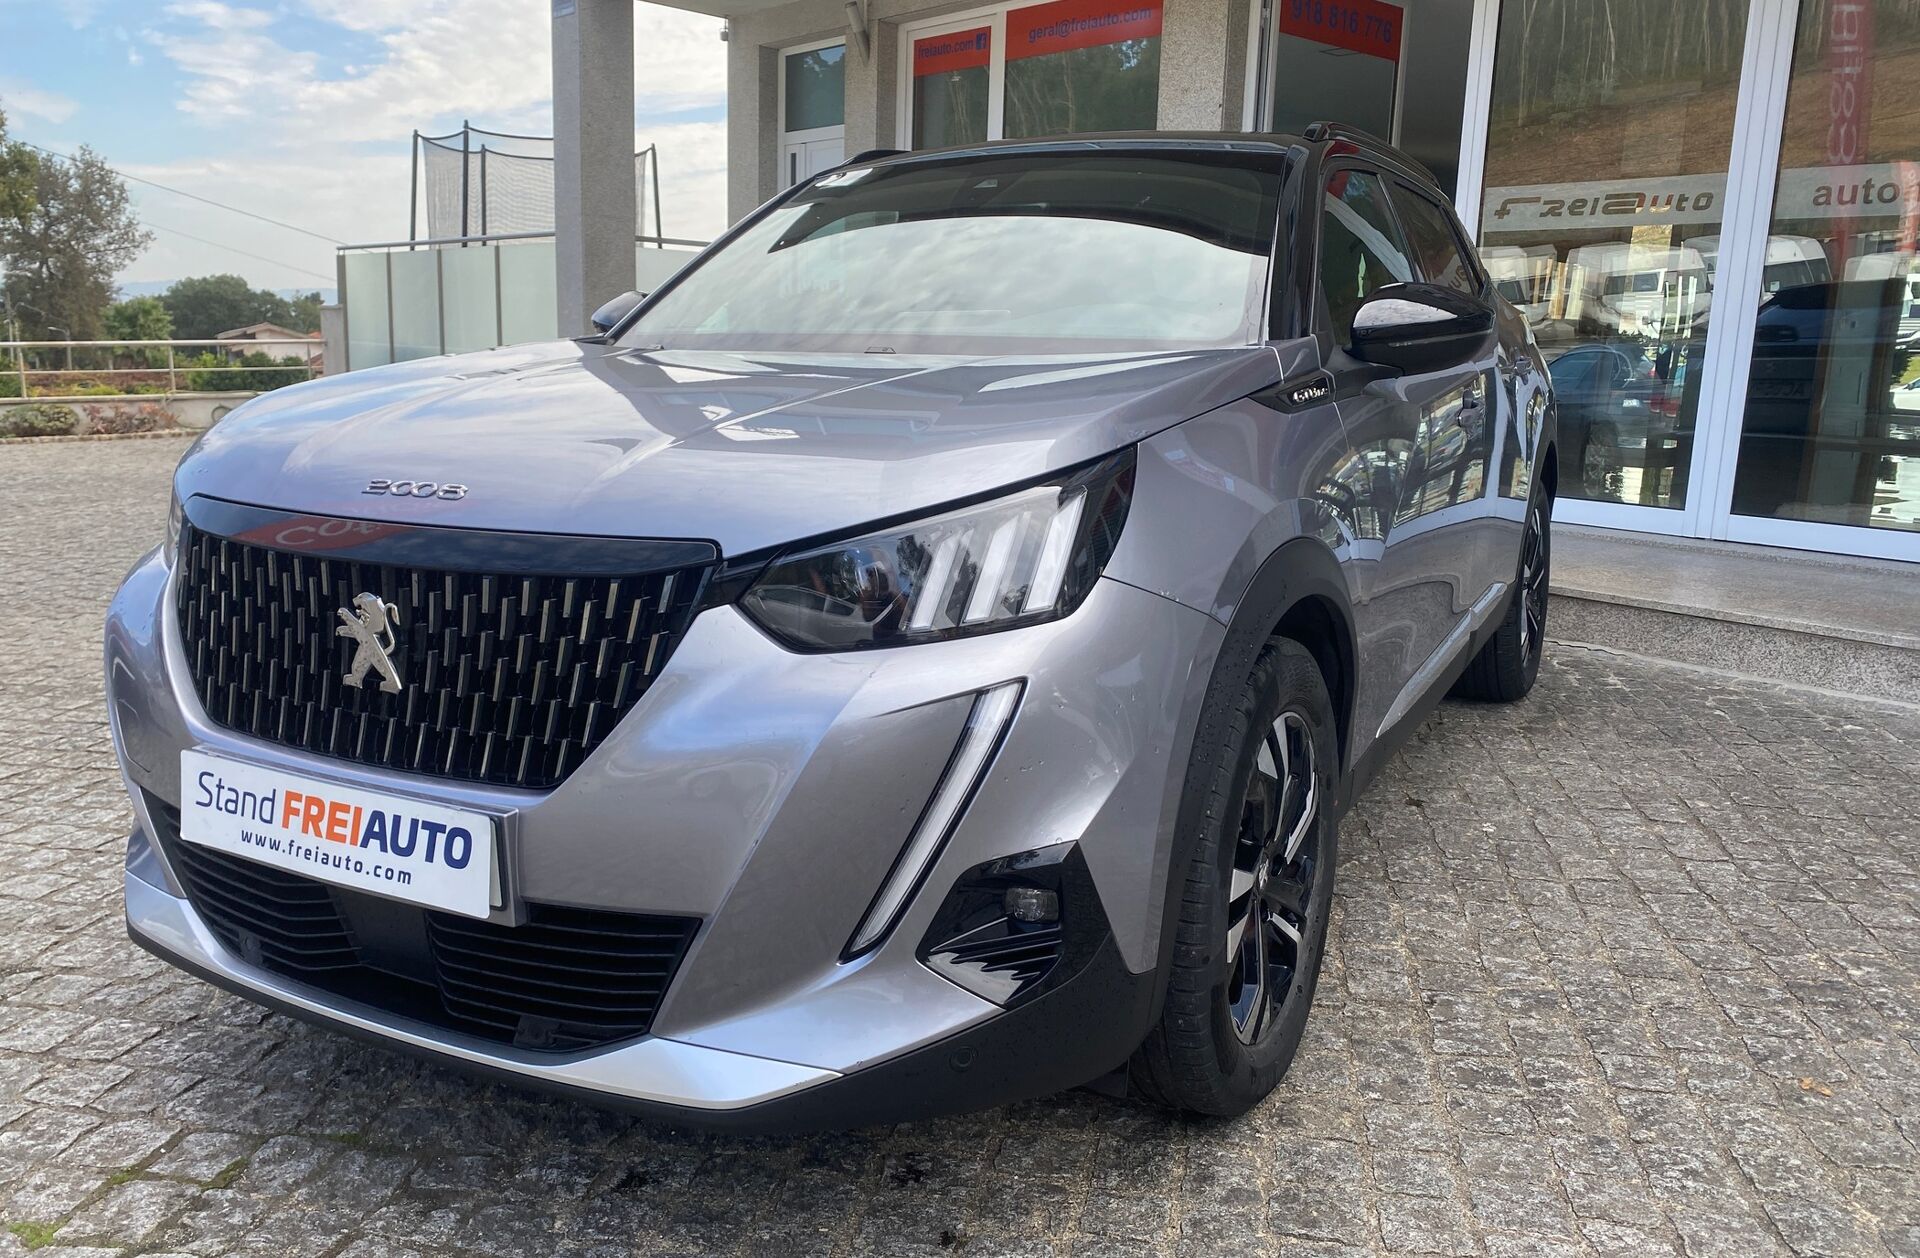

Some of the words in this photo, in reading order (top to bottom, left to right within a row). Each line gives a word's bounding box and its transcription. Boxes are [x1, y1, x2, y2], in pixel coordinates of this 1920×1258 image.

[1028, 7, 1152, 43] geral@freiauto.com
[1812, 178, 1900, 206] auto
[361, 478, 469, 501] 2008
[195, 771, 277, 825] Stand
[281, 790, 473, 870] FREIAUTO
[240, 829, 413, 886] www.freiauto.com
